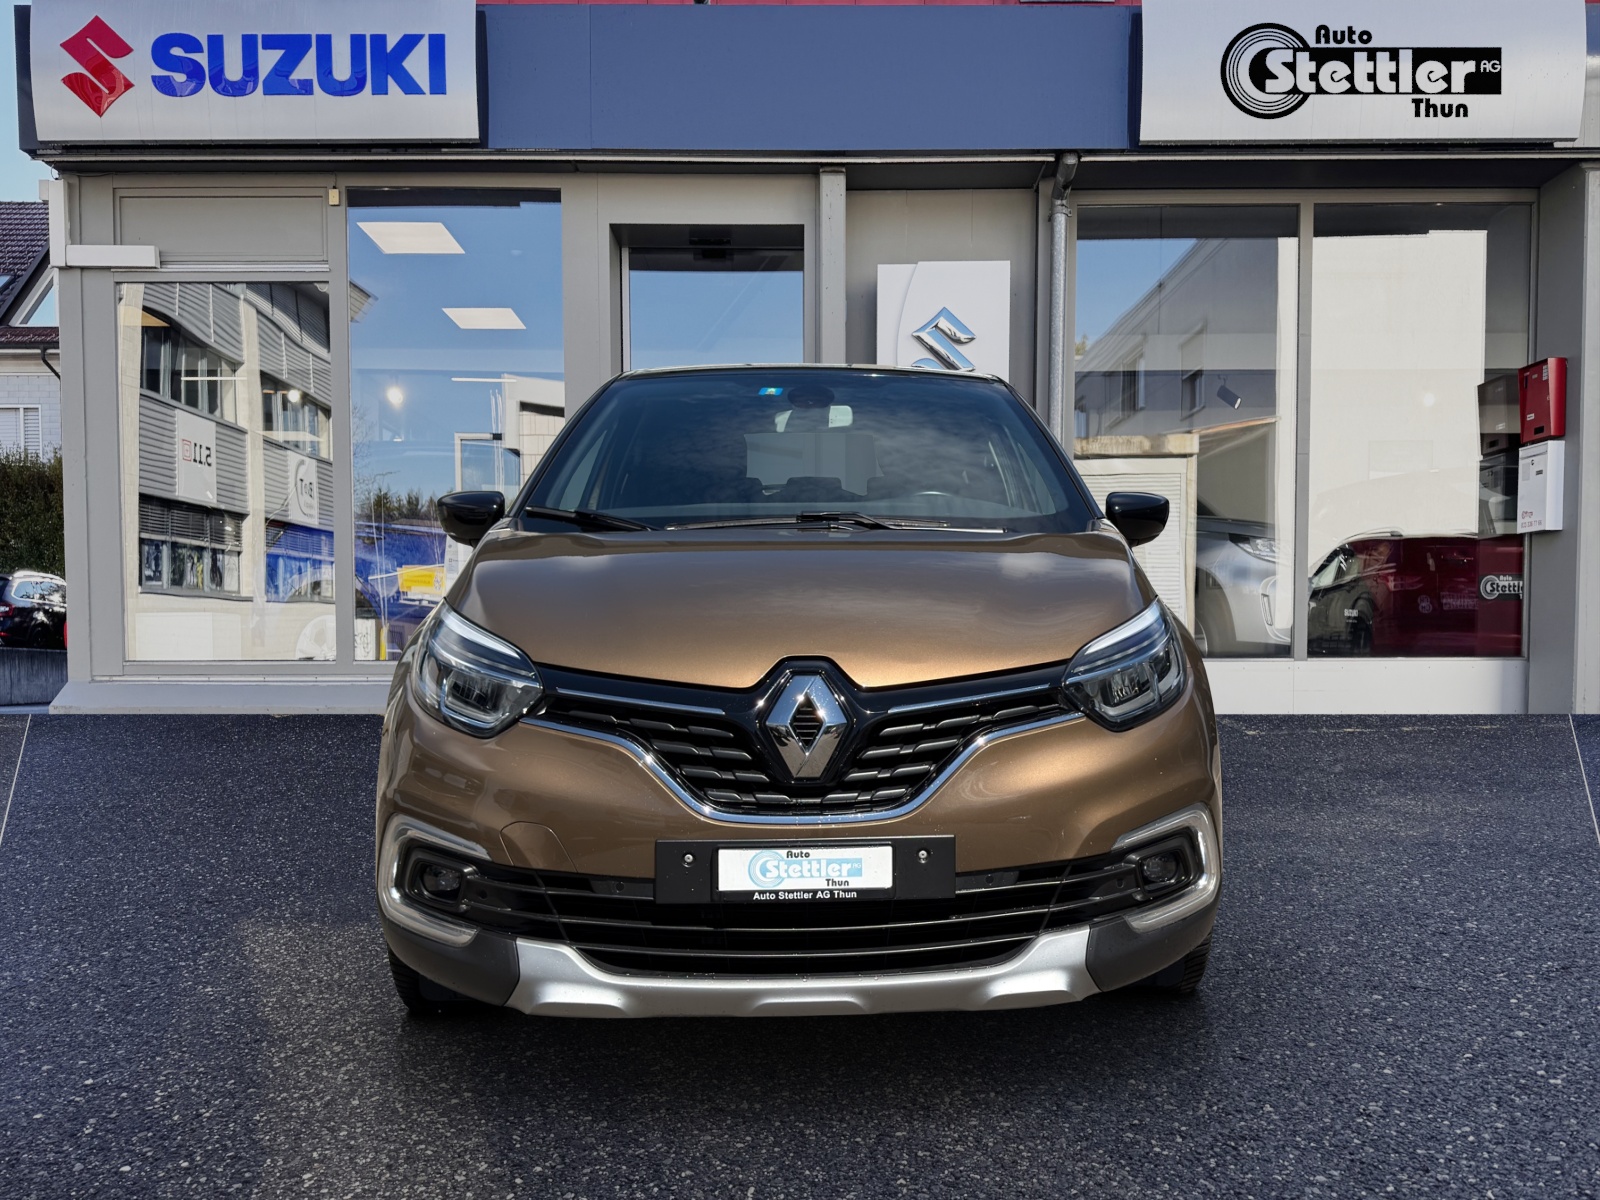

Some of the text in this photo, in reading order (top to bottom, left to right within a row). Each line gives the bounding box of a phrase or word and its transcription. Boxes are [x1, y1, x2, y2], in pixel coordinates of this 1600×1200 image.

[1315, 24, 1373, 45] Auto
[150, 32, 447, 97] SUZUKI
[1265, 48, 1501, 94] Stettler AG
[1411, 97, 1469, 118] Thun
[786, 850, 811, 859] Auto
[765, 859, 852, 878] Stettler
[825, 878, 850, 887] Thun
[753, 890, 857, 900] Auto Stettler AG Thun
